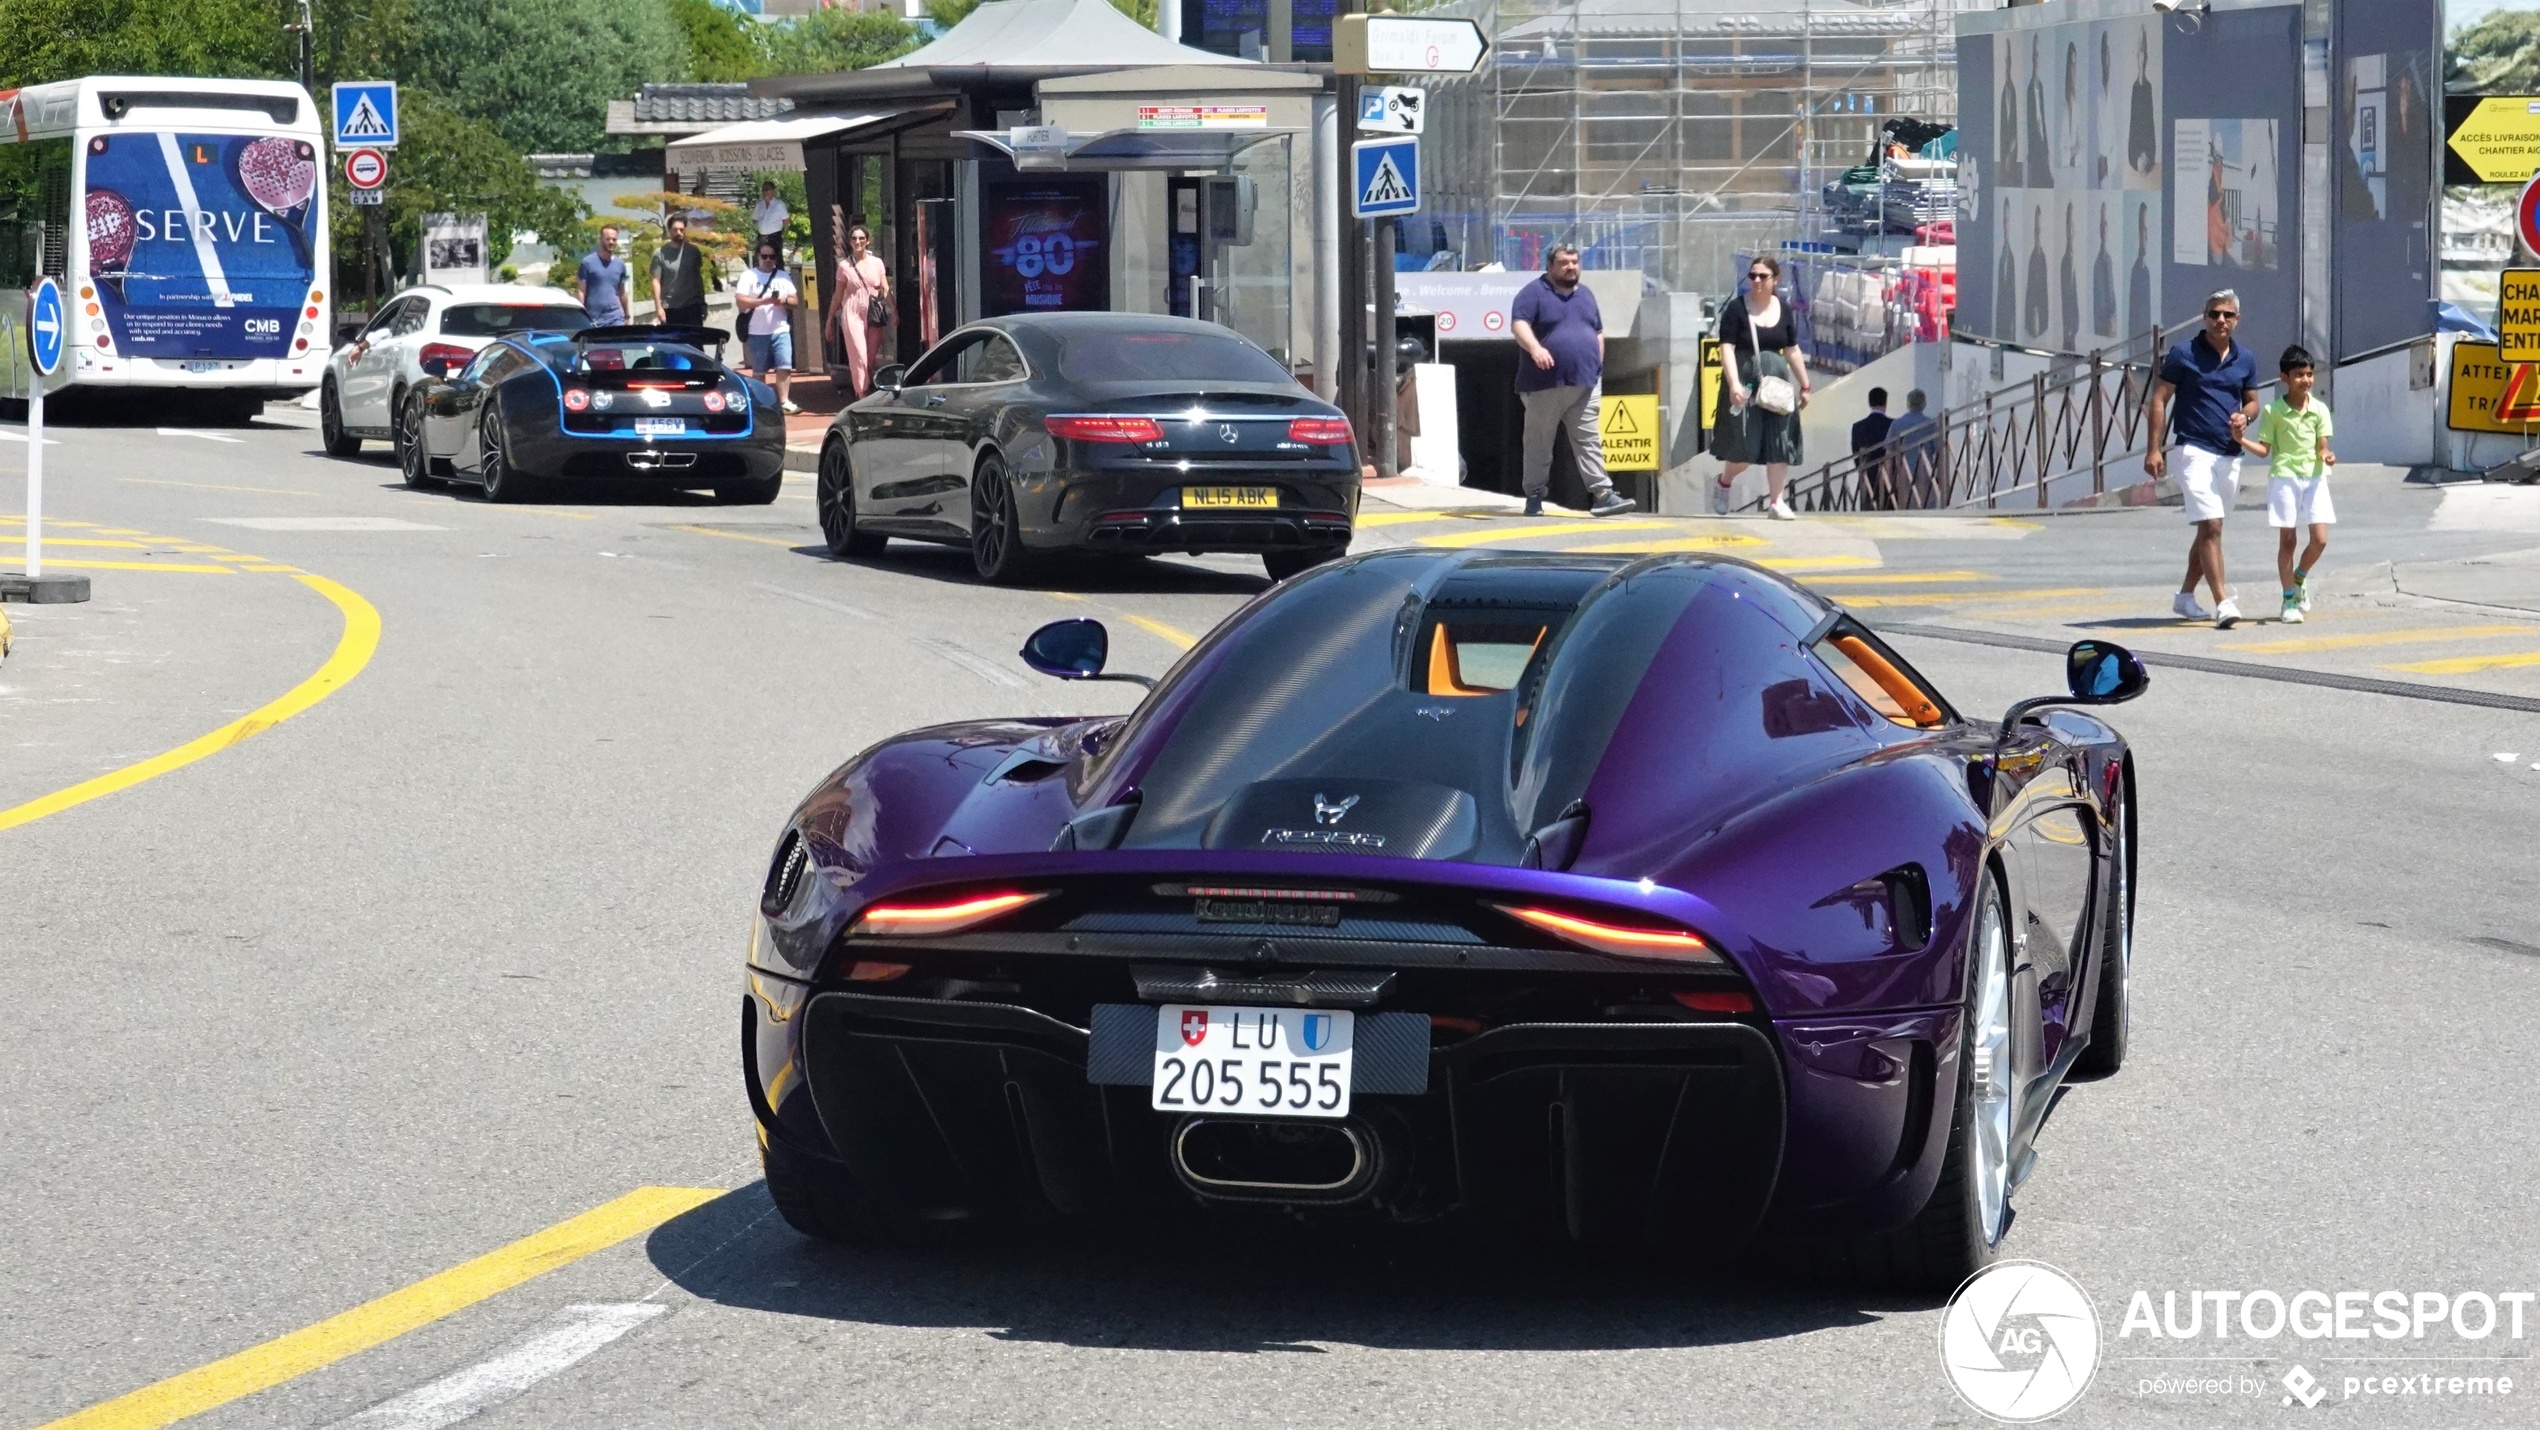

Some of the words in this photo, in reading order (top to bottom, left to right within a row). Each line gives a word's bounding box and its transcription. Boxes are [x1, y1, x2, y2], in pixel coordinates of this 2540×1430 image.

[1372, 27, 1419, 44] Grimaldi
[1425, 29, 1457, 45] Forum
[2460, 132, 2492, 142] ACCÈS
[196, 146, 208, 163] L
[758, 147, 785, 161] GLACES
[353, 196, 378, 204] CAM
[135, 209, 275, 243] SERVE
[1016, 232, 1074, 277] 80
[1024, 280, 1041, 293] FÊTE
[1420, 285, 1471, 296] Welcome
[1025, 294, 1062, 305] MUSIQUE
[142, 321, 166, 329] respond
[245, 319, 280, 333] CMB
[1440, 317, 1452, 325] 20
[143, 328, 160, 336] speed
[2502, 332, 2540, 349] ENT
[1194, 488, 1231, 505] NL15
[1236, 488, 1268, 505] ABK
[1232, 1012, 1278, 1049] LU
[1160, 1057, 1243, 1106] 205
[1259, 1060, 1341, 1110] 555
